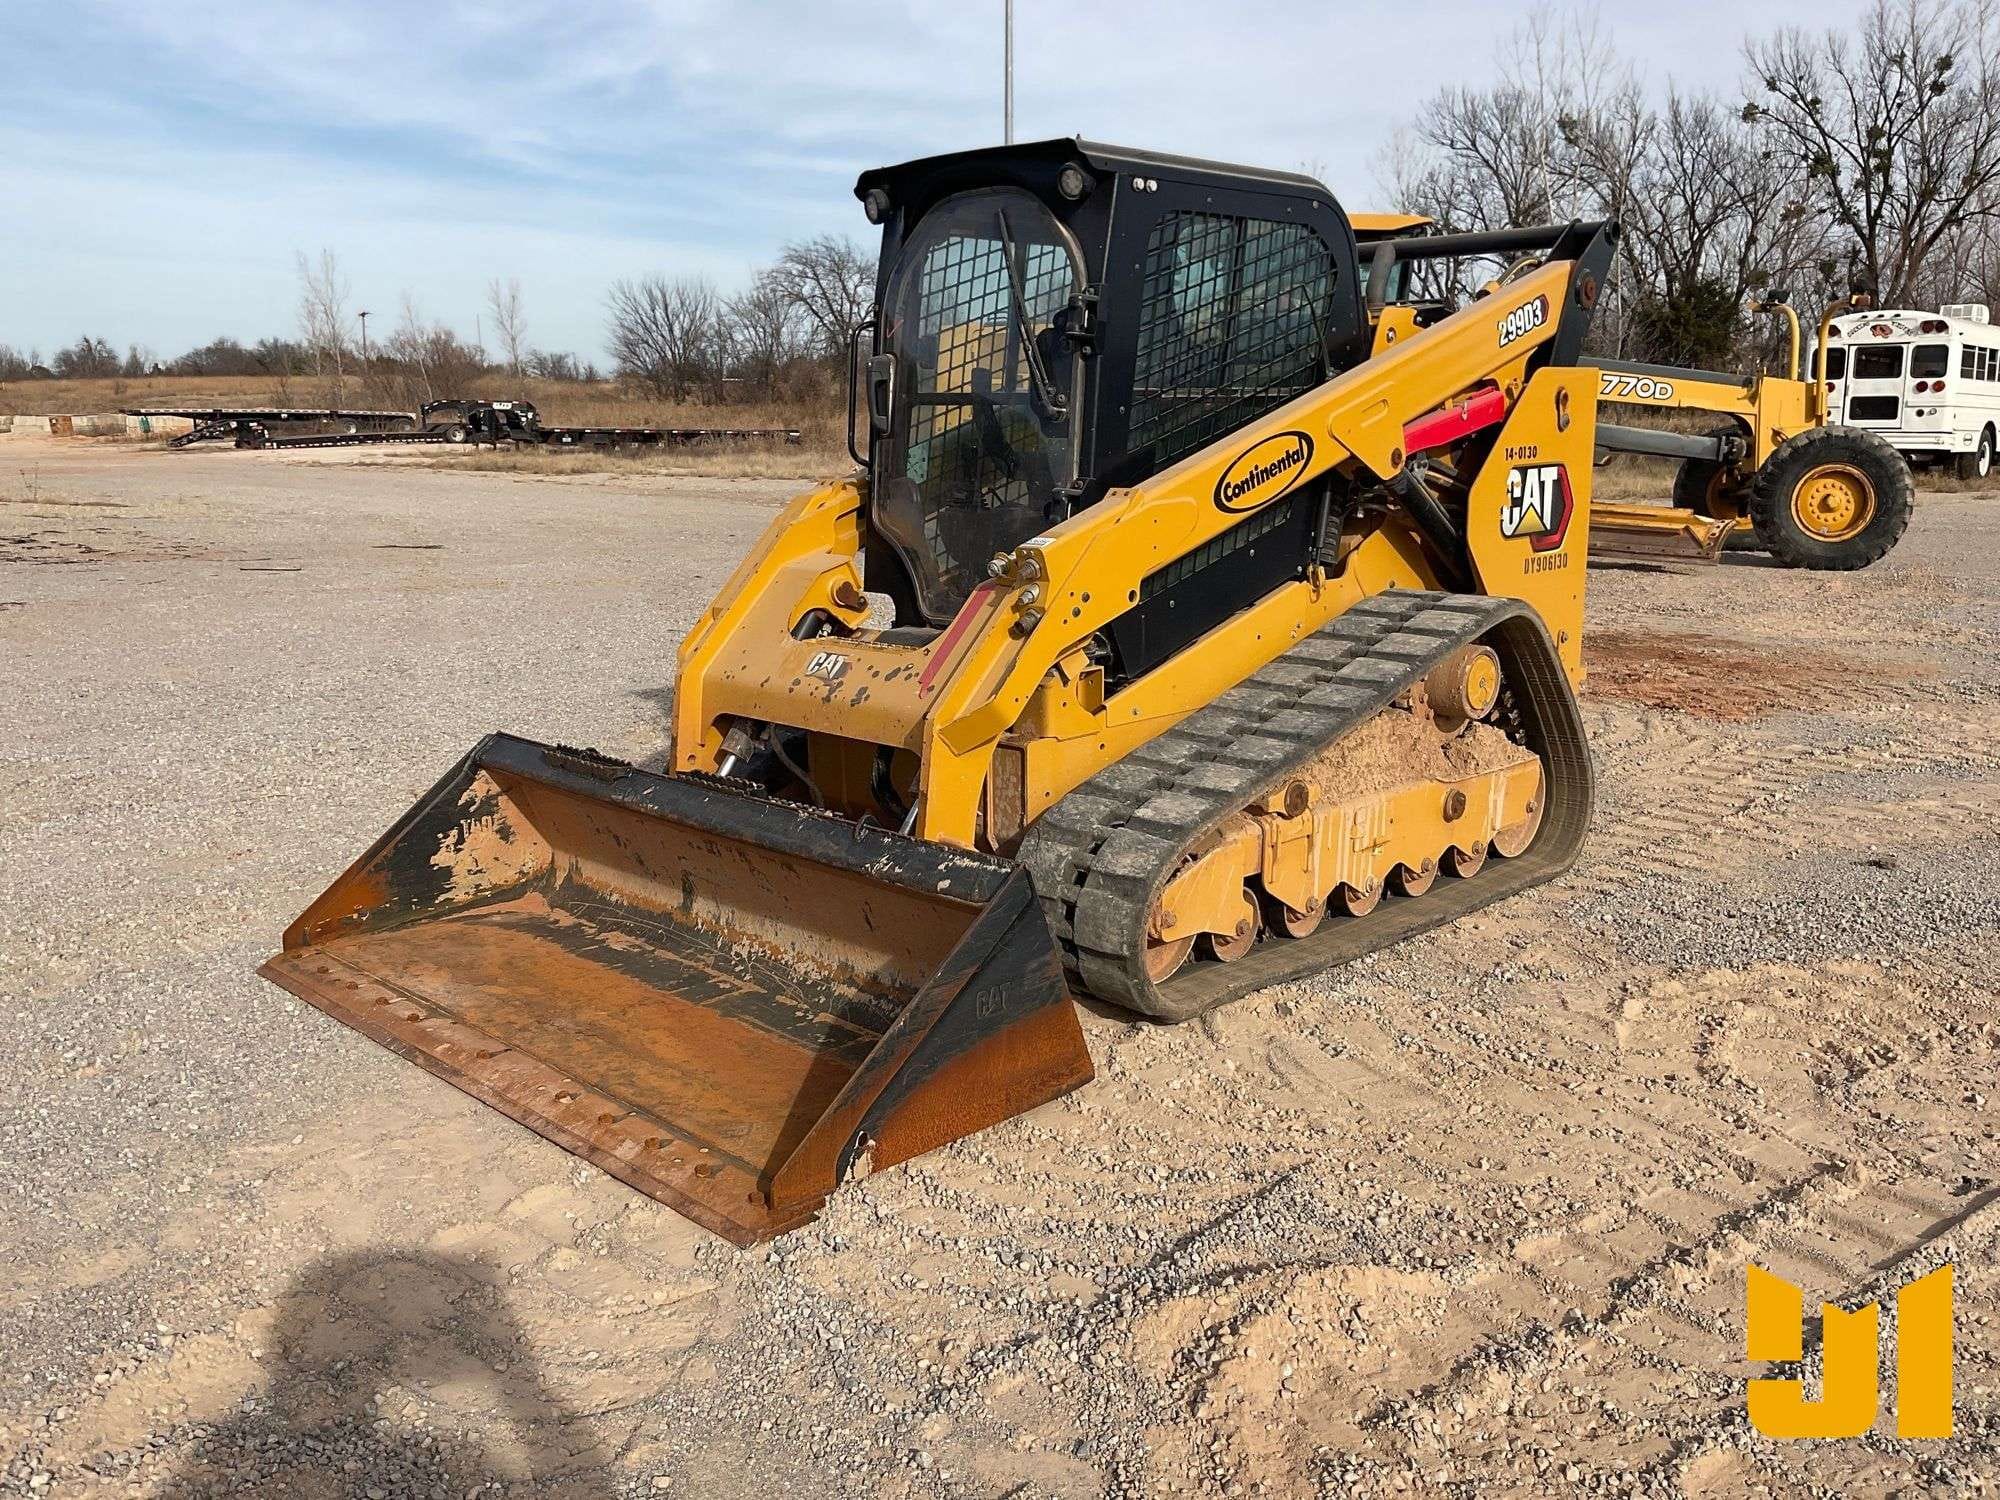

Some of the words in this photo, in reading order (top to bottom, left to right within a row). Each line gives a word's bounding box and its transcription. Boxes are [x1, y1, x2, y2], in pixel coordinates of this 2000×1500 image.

[1498, 297, 1543, 348] 299D3
[1602, 374, 1673, 400] 770D
[1505, 446, 1538, 460] 14-0130
[1222, 436, 1305, 503] Continental
[1501, 466, 1559, 537] CAT
[1524, 553, 1568, 574] DY906130
[806, 652, 848, 679] CAT
[977, 981, 1013, 1019] CAT
